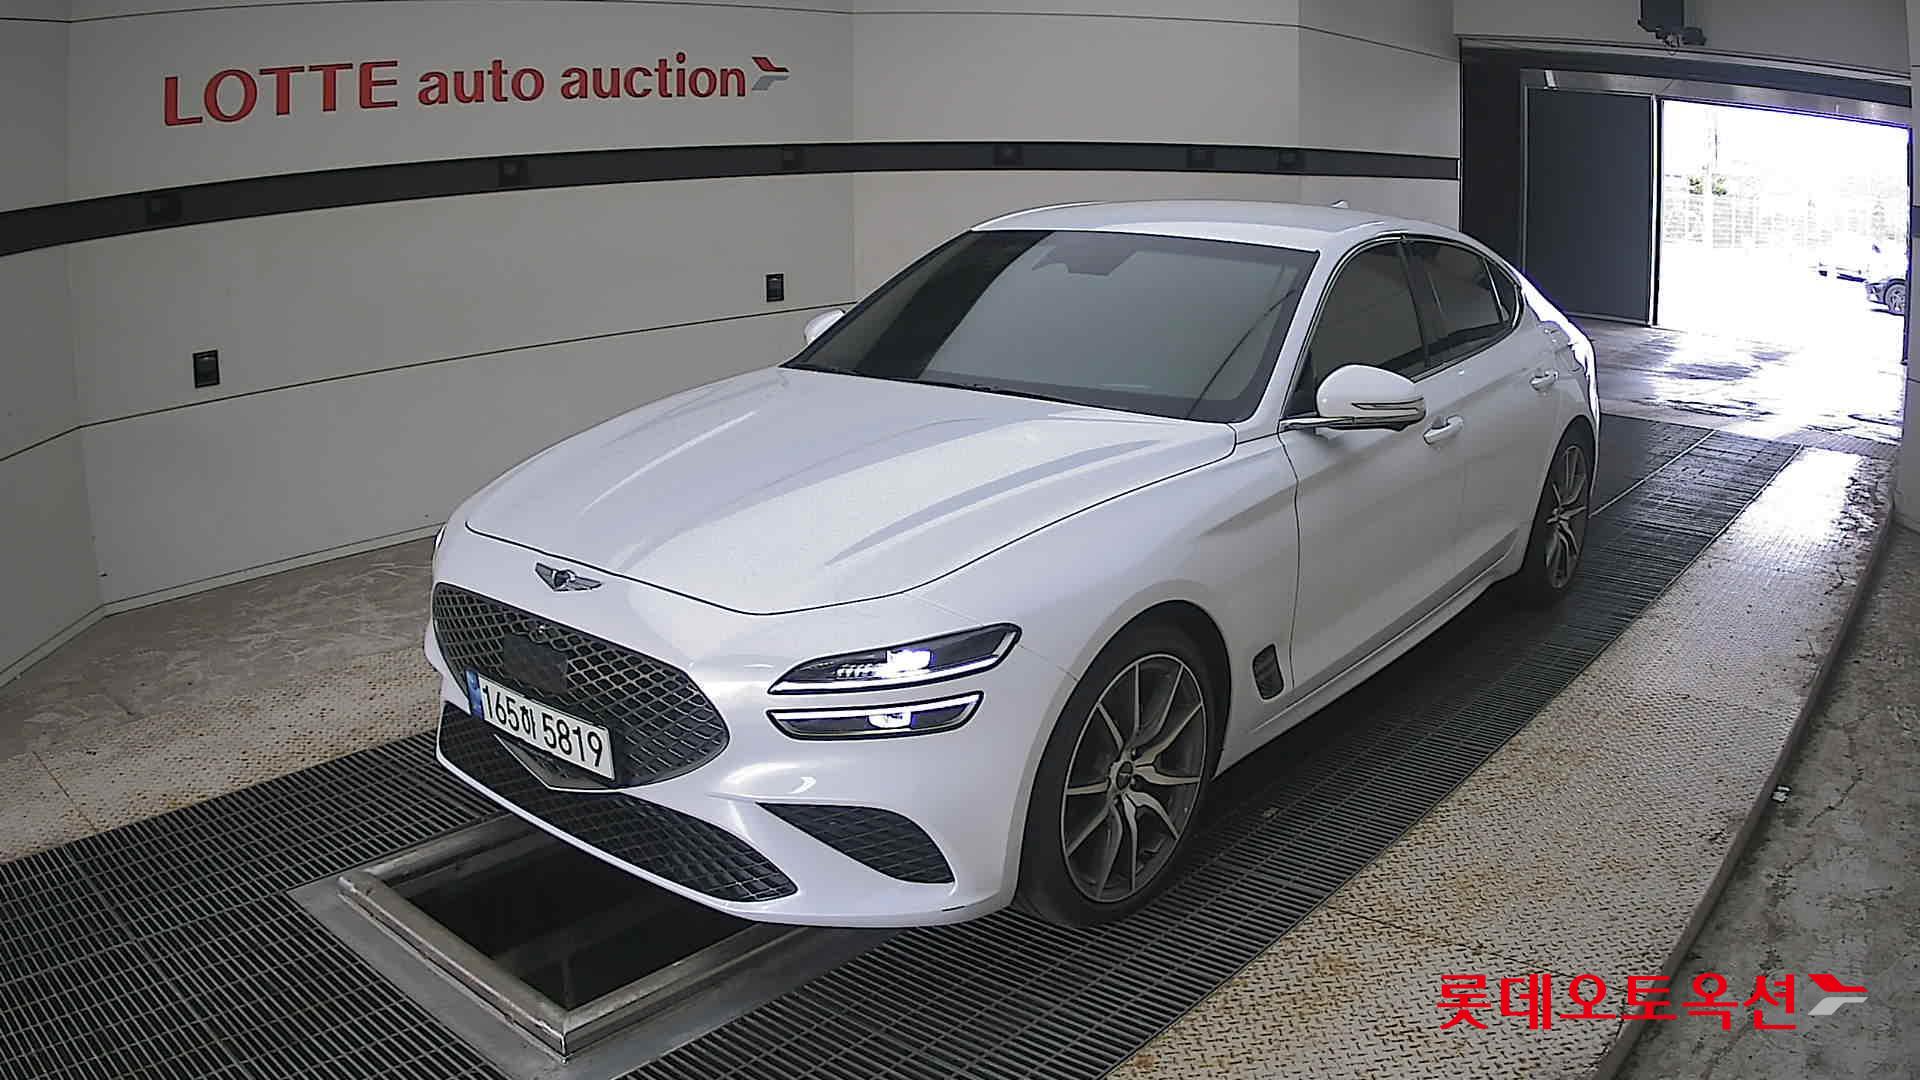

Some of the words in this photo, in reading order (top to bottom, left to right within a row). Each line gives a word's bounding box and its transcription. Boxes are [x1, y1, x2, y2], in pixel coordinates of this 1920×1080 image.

[163, 60, 400, 127] LOTTE
[416, 59, 545, 106] auto
[559, 53, 748, 98] auction
[541, 711, 603, 767] 5819
